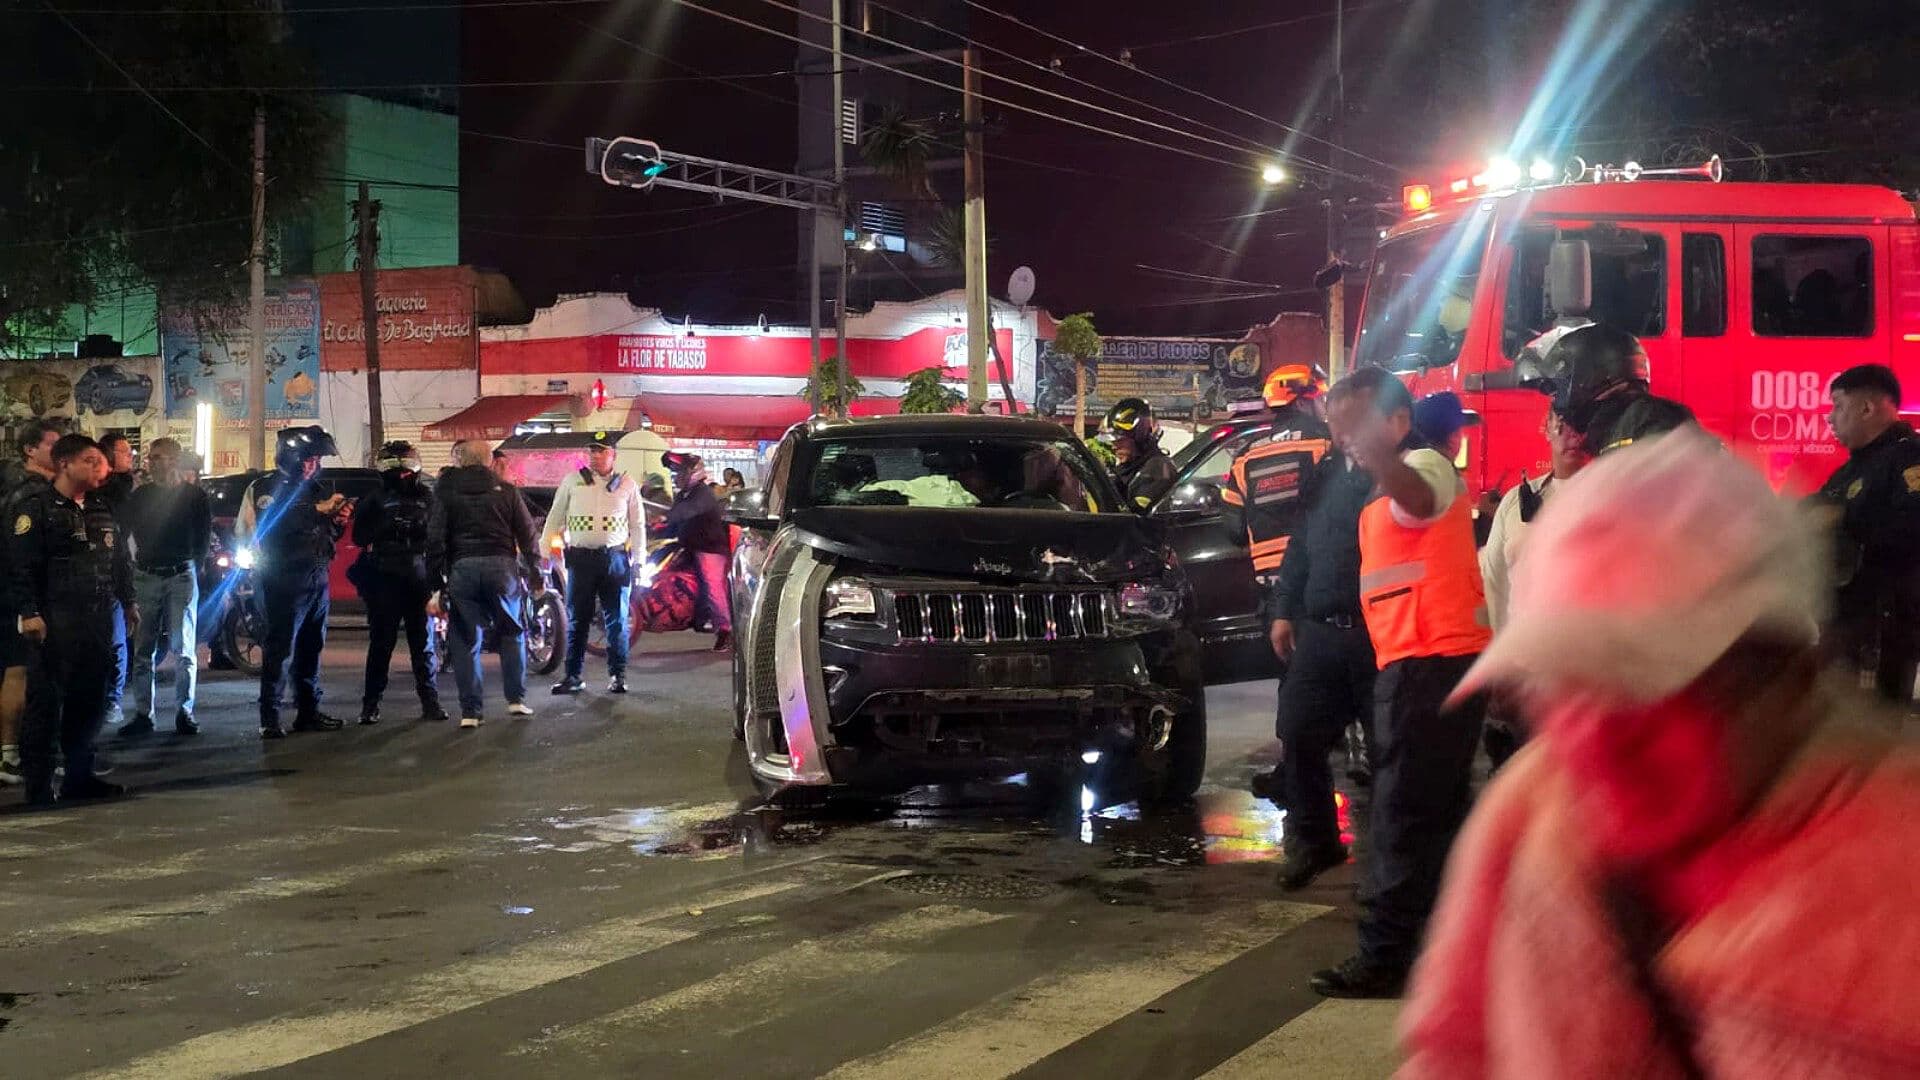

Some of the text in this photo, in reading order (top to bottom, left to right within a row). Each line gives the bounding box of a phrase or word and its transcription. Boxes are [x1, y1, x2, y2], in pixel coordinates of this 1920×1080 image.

[323, 319, 336, 341] El
[384, 319, 400, 343] De
[402, 316, 470, 342] Baghdad
[618, 348, 707, 370] LA FLOR DE TABASCO
[1138, 342, 1158, 360] DE
[1159, 342, 1211, 361] MOTOS
